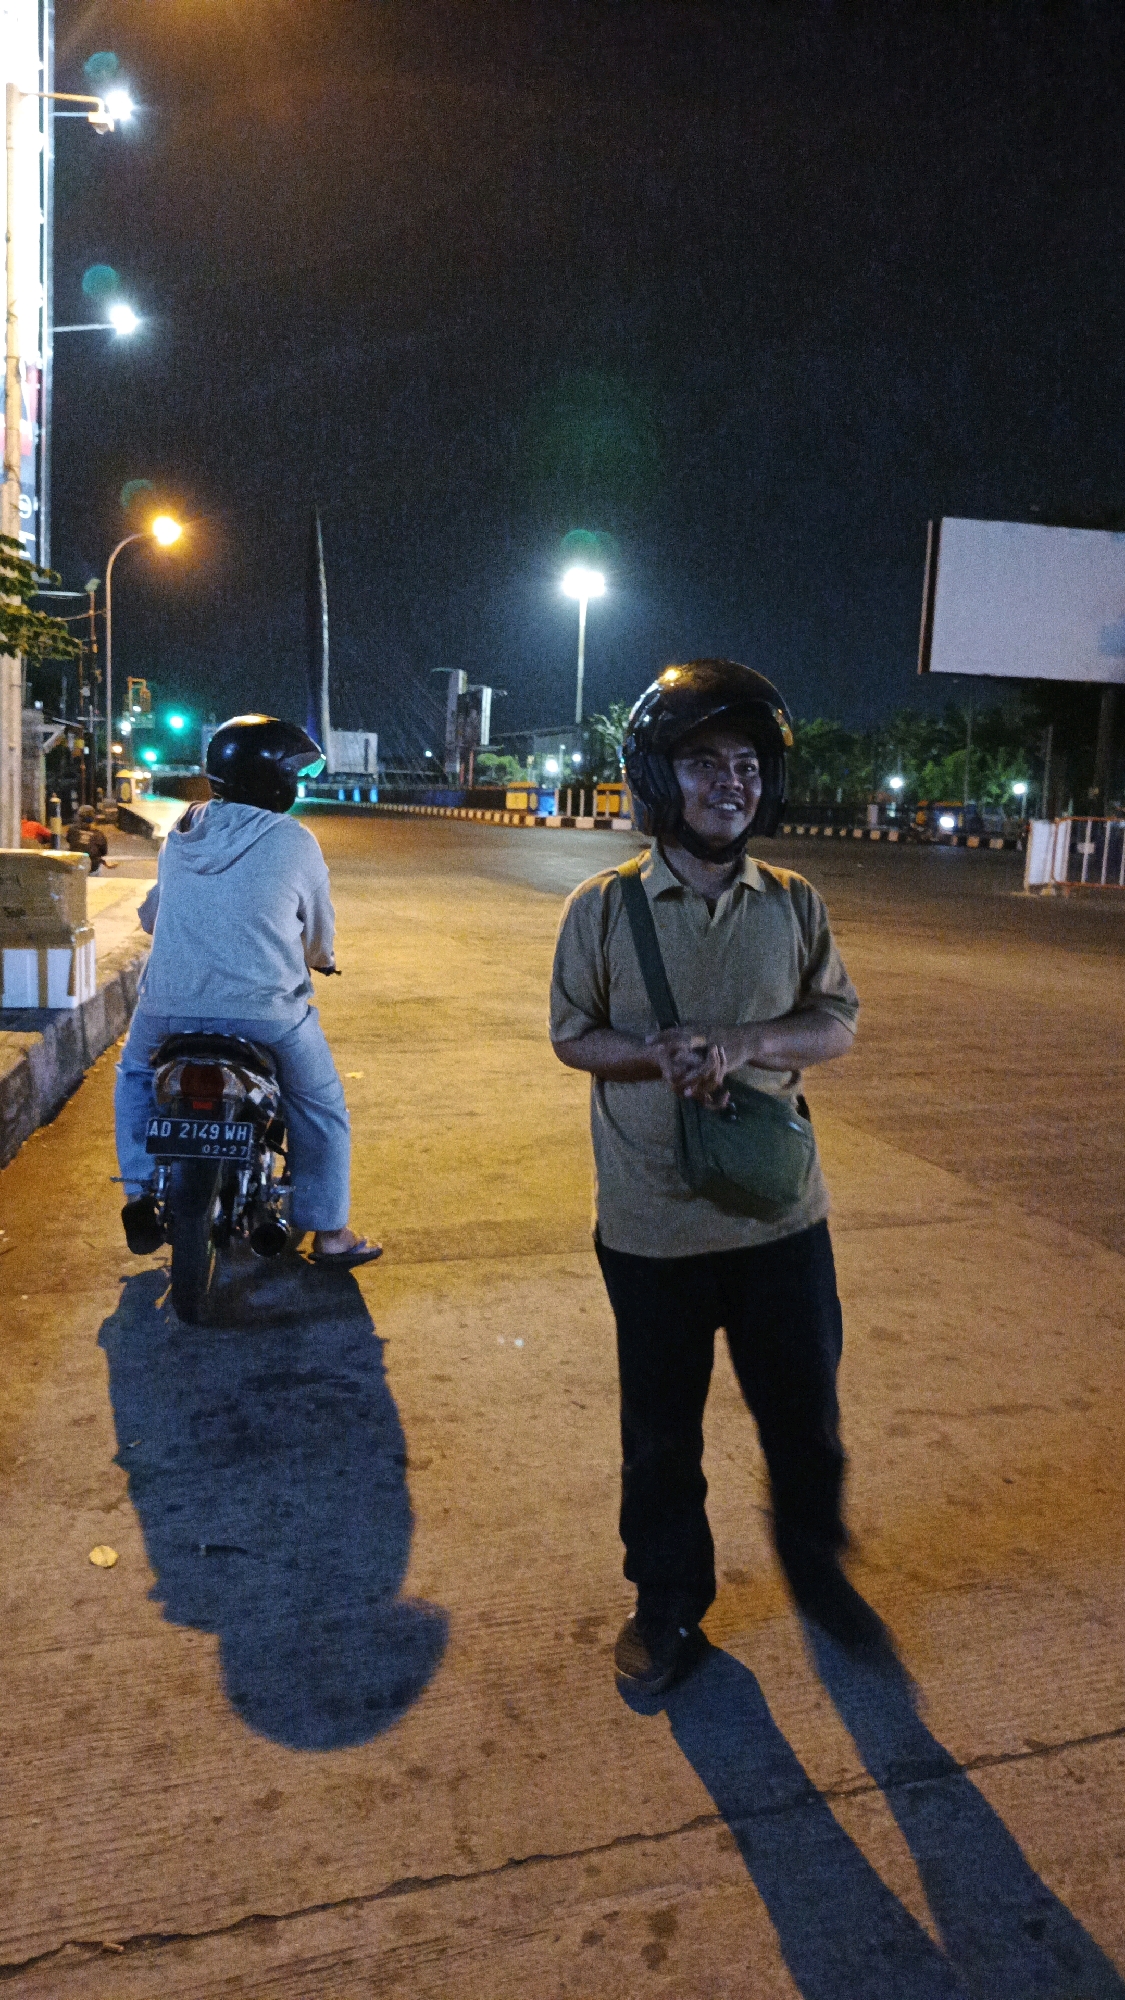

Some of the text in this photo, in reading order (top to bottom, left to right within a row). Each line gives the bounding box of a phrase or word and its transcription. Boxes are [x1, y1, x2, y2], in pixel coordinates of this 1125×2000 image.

[149, 1120, 248, 1141] AD 2149 WH
